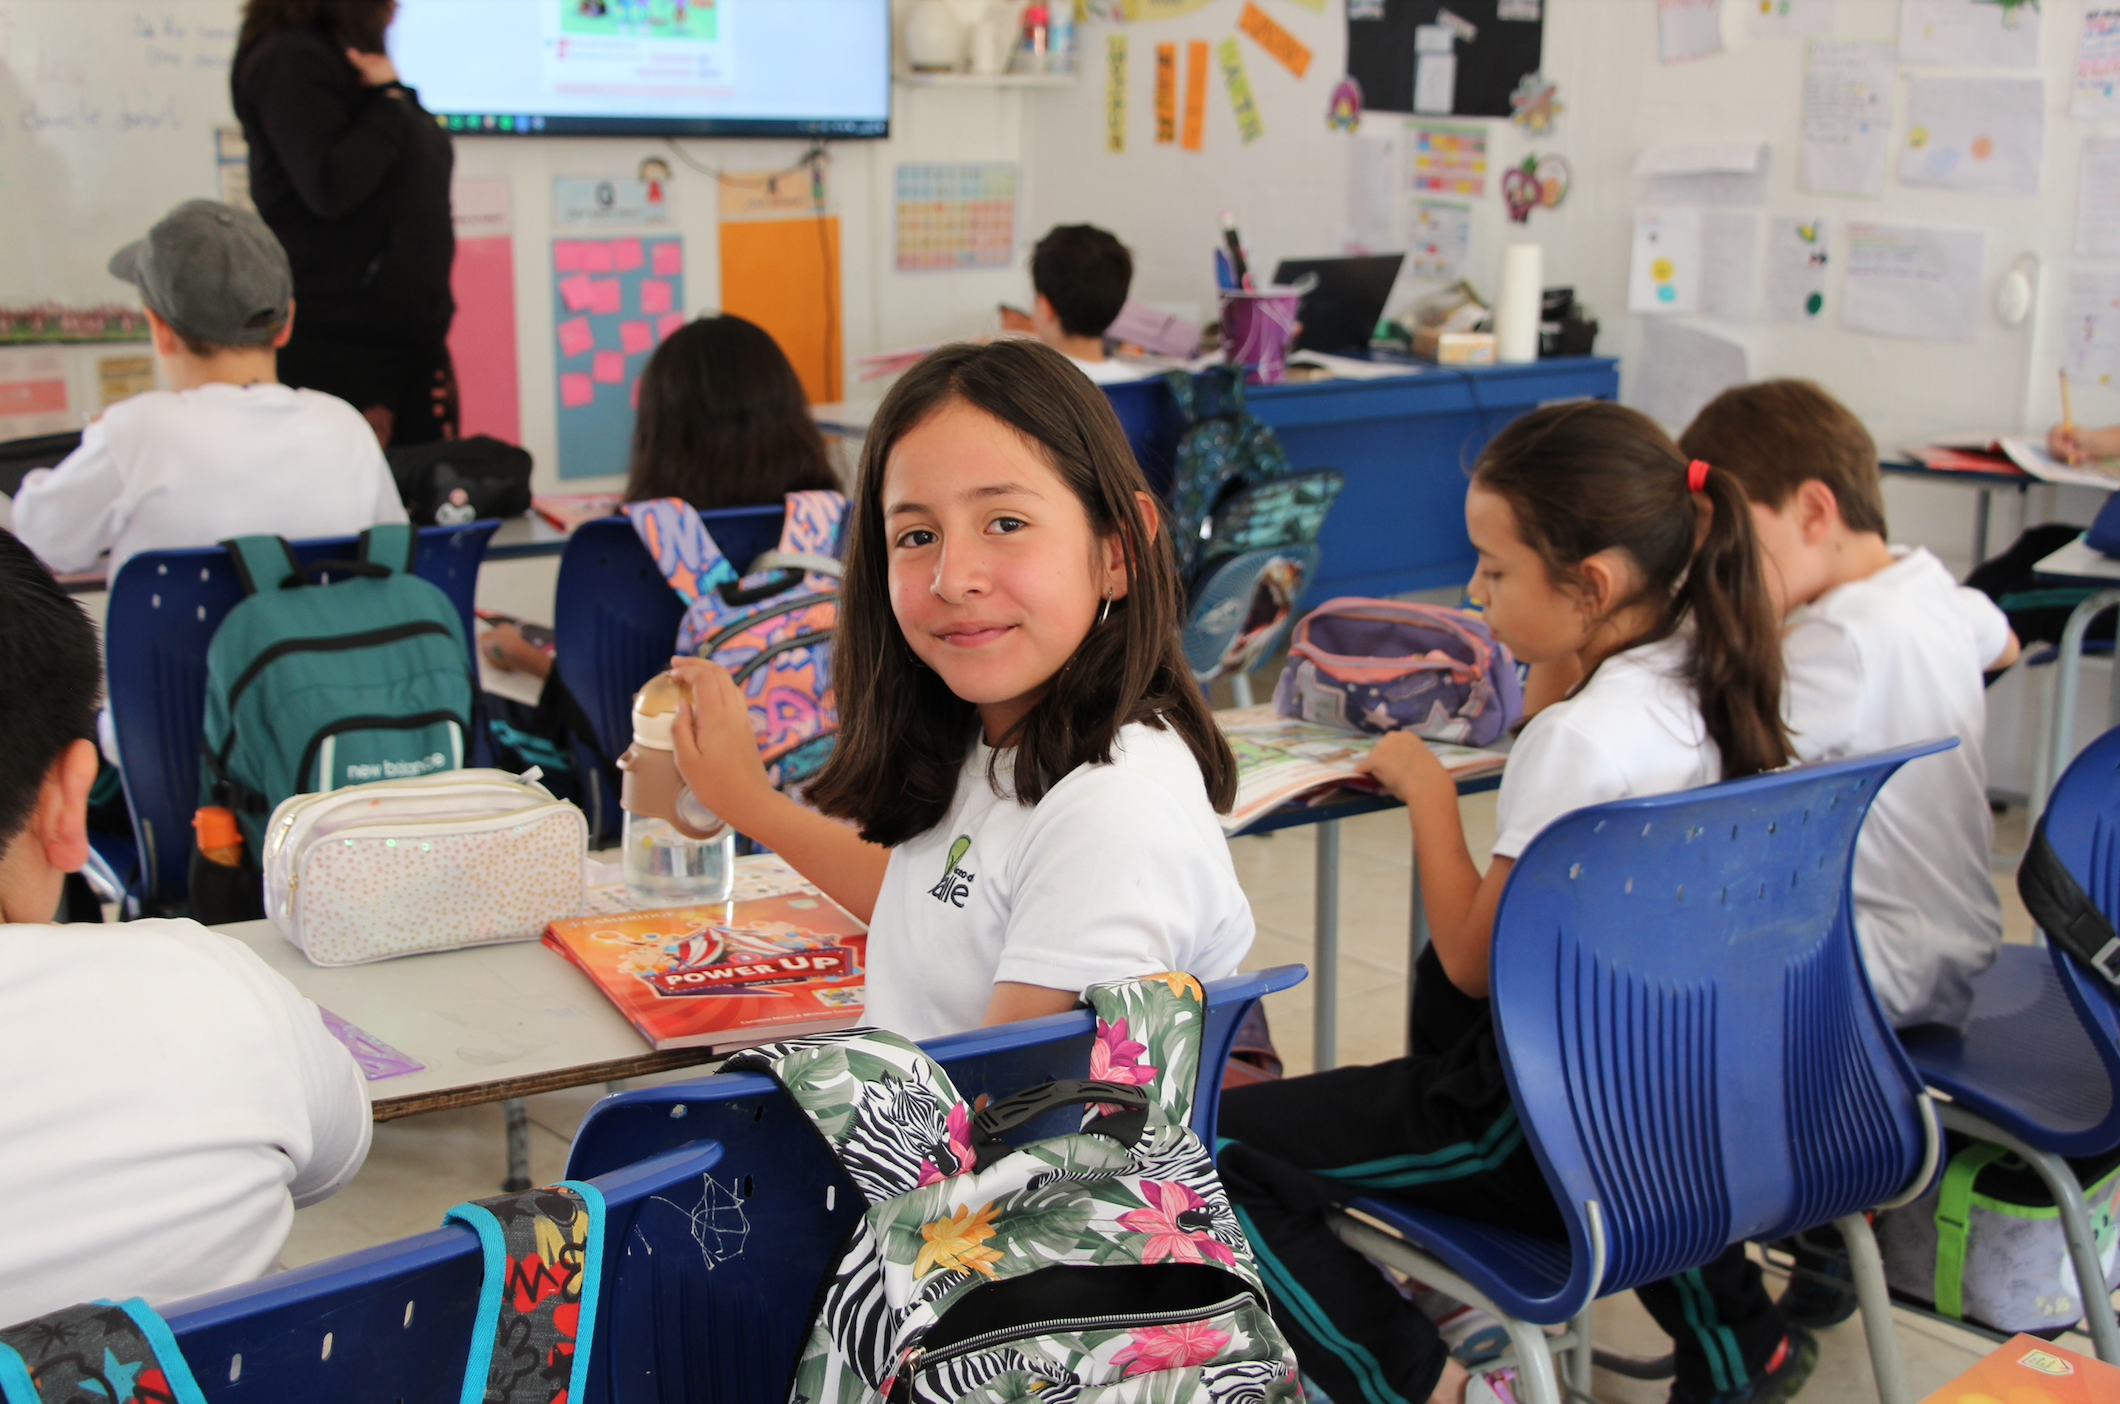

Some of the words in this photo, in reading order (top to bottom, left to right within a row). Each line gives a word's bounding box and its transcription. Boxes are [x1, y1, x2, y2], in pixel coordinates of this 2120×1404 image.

[346, 764, 382, 780] new
[383, 752, 446, 777] balance
[664, 964, 778, 985] POWER
[777, 955, 841, 971] UP
